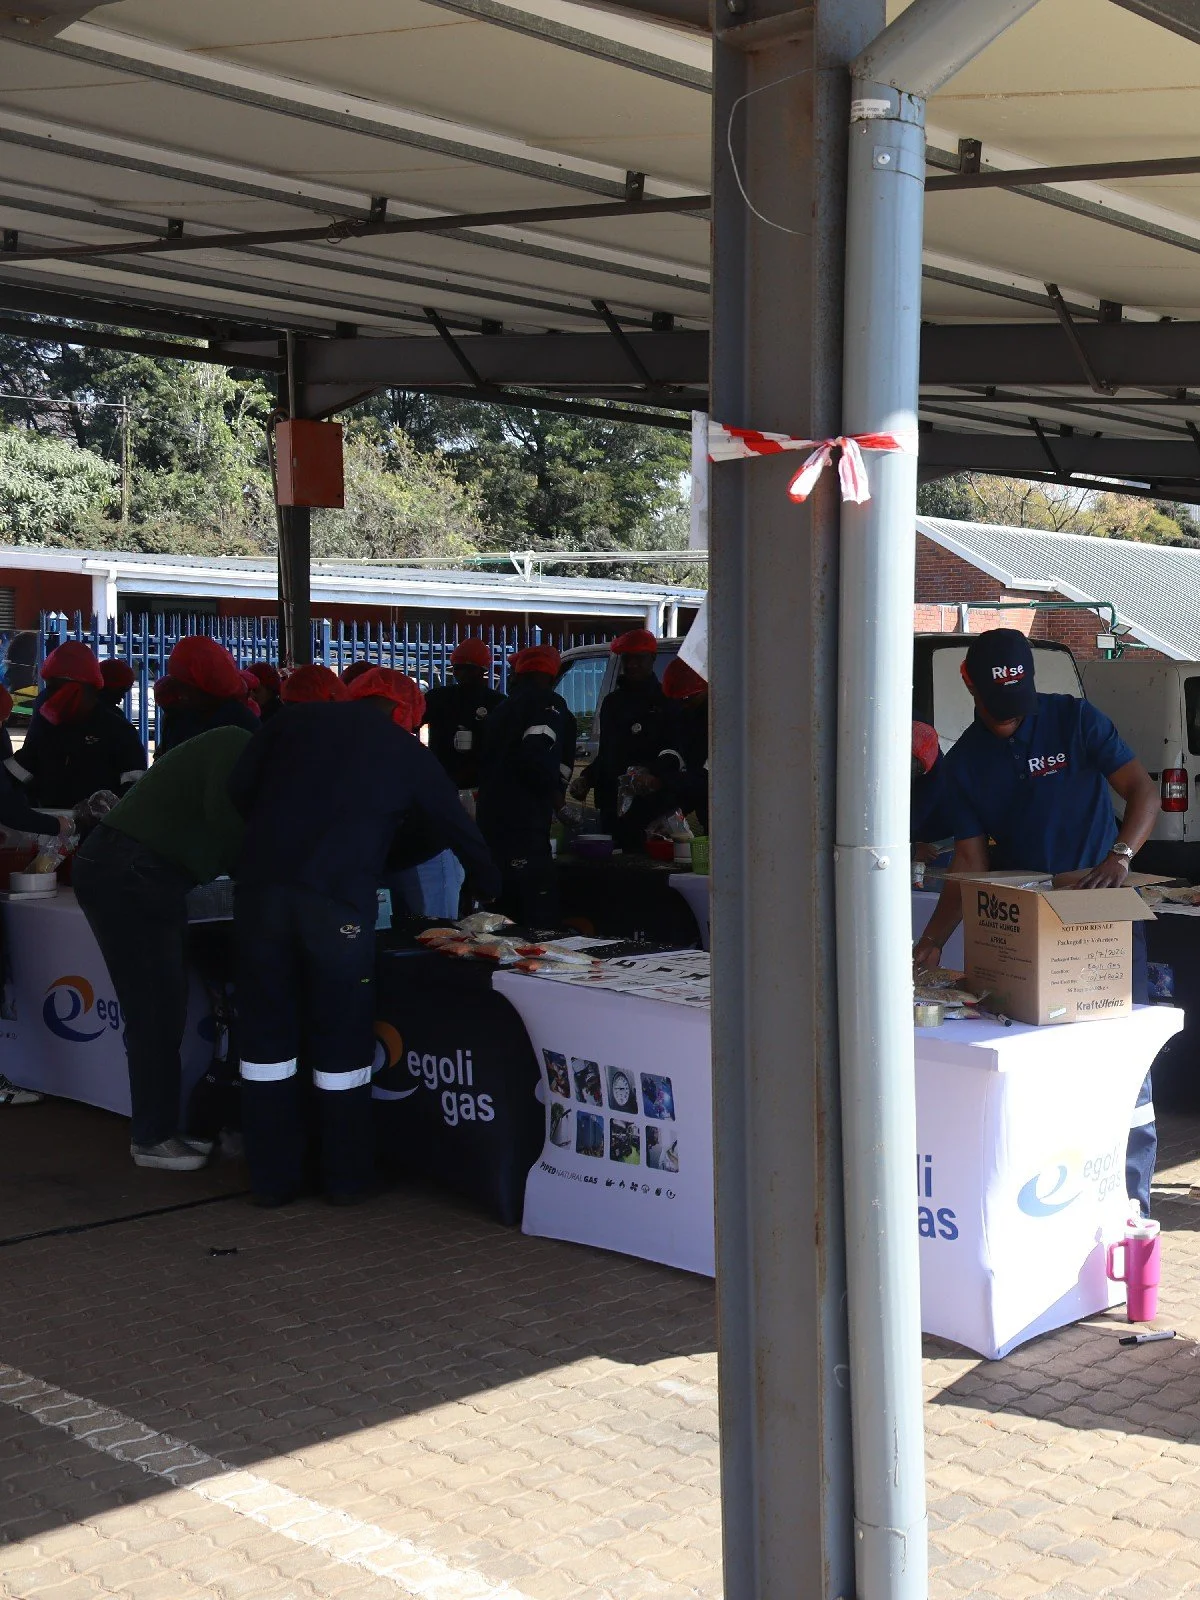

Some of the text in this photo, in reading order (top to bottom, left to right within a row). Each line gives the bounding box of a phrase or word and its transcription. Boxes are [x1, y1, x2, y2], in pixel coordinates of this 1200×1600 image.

[97, 998, 122, 1030] eg
[406, 1049, 474, 1090] egoli
[441, 1090, 495, 1126] gas
[918, 1205, 959, 1241] as
